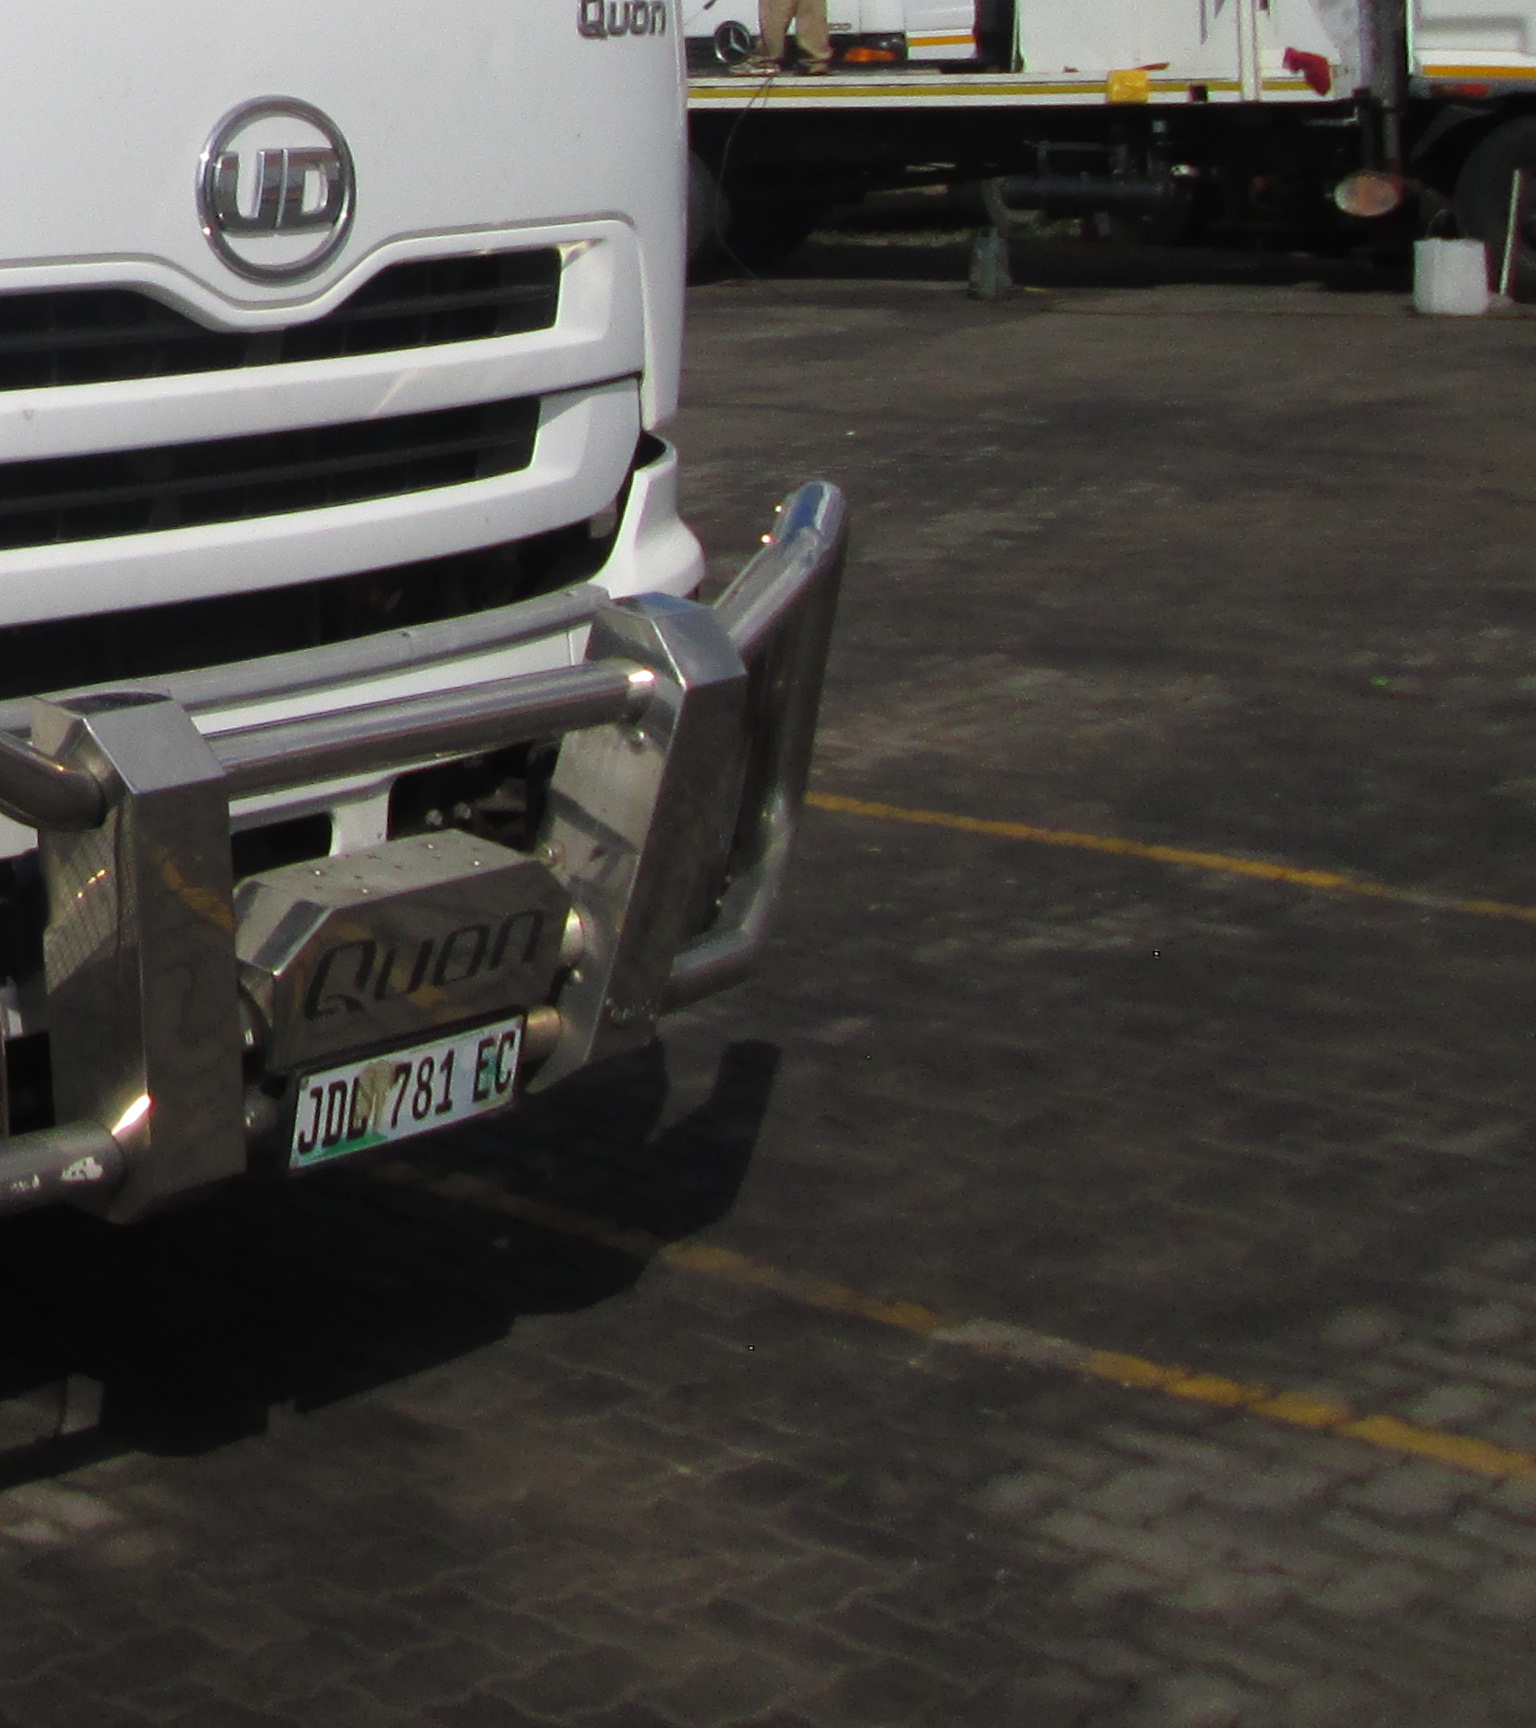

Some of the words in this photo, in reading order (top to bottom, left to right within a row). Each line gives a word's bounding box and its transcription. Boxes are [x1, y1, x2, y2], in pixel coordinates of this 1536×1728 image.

[211, 146, 342, 238] UD
[297, 1075, 368, 1154] JDL
[390, 1048, 455, 1129] 781
[471, 1029, 516, 1103] EC
